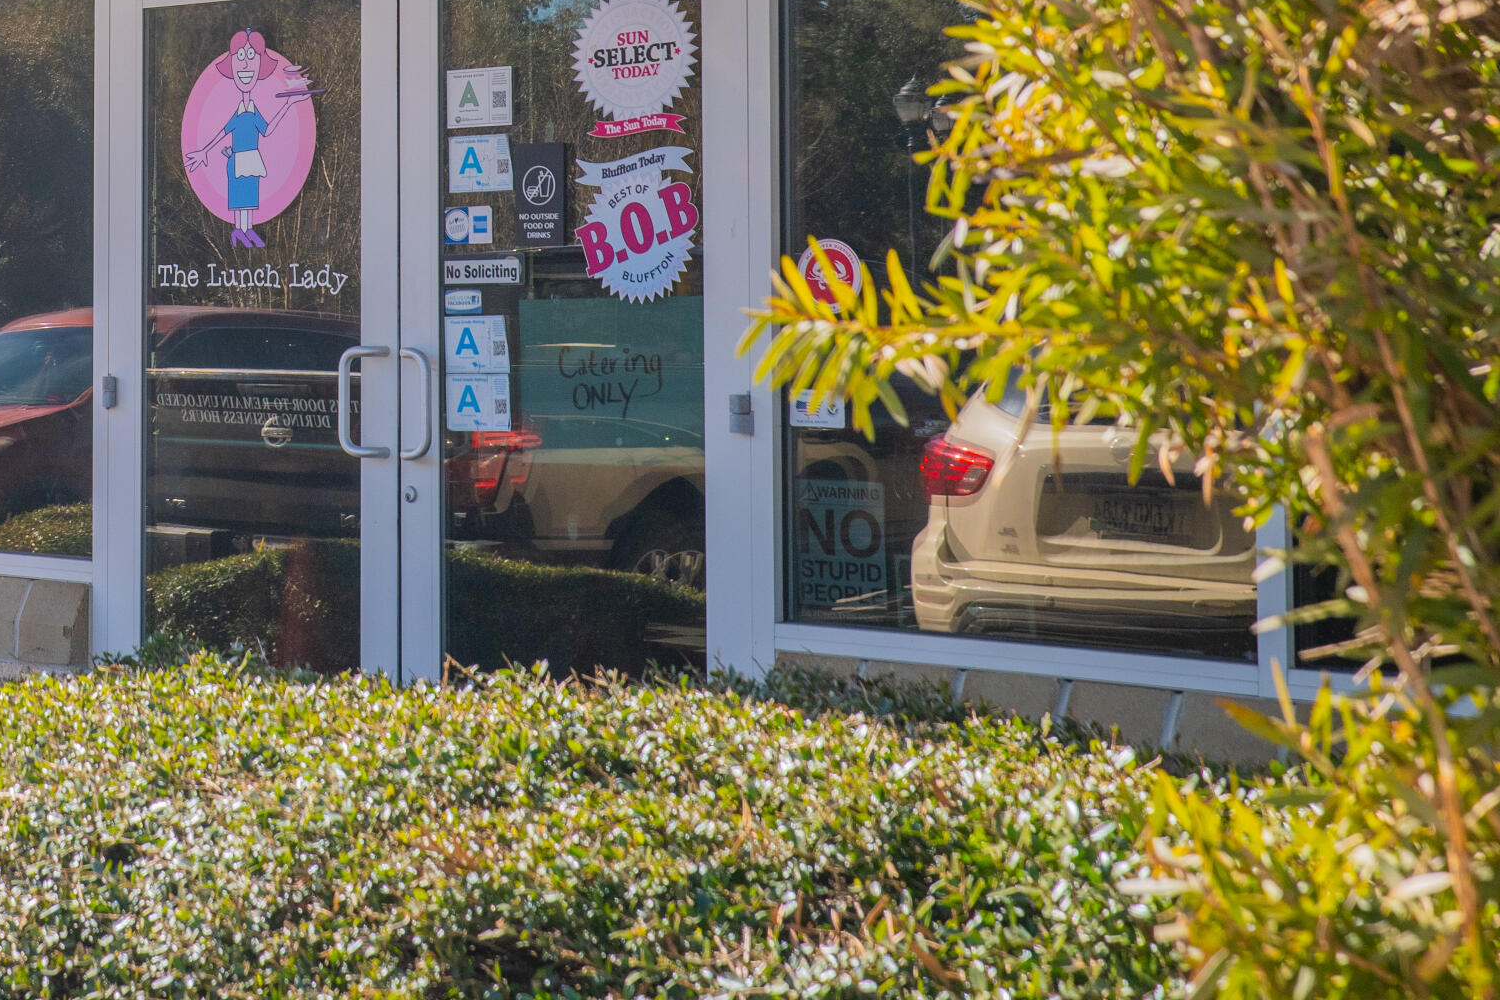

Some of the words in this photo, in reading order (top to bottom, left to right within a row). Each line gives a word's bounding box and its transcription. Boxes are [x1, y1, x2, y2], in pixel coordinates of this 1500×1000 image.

[617, 30, 650, 46] SUN
[593, 41, 677, 68] SELECT
[612, 63, 661, 80] TODAY
[459, 80, 479, 108] A
[604, 124, 621, 135] The
[623, 119, 640, 131] Sun
[641, 116, 667, 128] Today
[459, 146, 483, 175] A
[602, 161, 638, 179] Bluffton
[638, 153, 666, 169] Today
[607, 187, 633, 209] BEST
[635, 184, 650, 194] OF
[527, 231, 551, 239] DRINKS
[158, 264, 199, 287] The
[207, 263, 281, 288] Lunch
[289, 263, 348, 295] Lady
[446, 265, 461, 279] No
[464, 263, 517, 281] Soliciting
[622, 251, 675, 283] BLUFFTON
[455, 327, 479, 355] A
[559, 346, 663, 398] Catering
[457, 385, 481, 413] A
[572, 378, 638, 420] ONLY
[817, 486, 880, 500] WARNING
[801, 507, 882, 558] NO
[801, 559, 882, 583] STUPID
